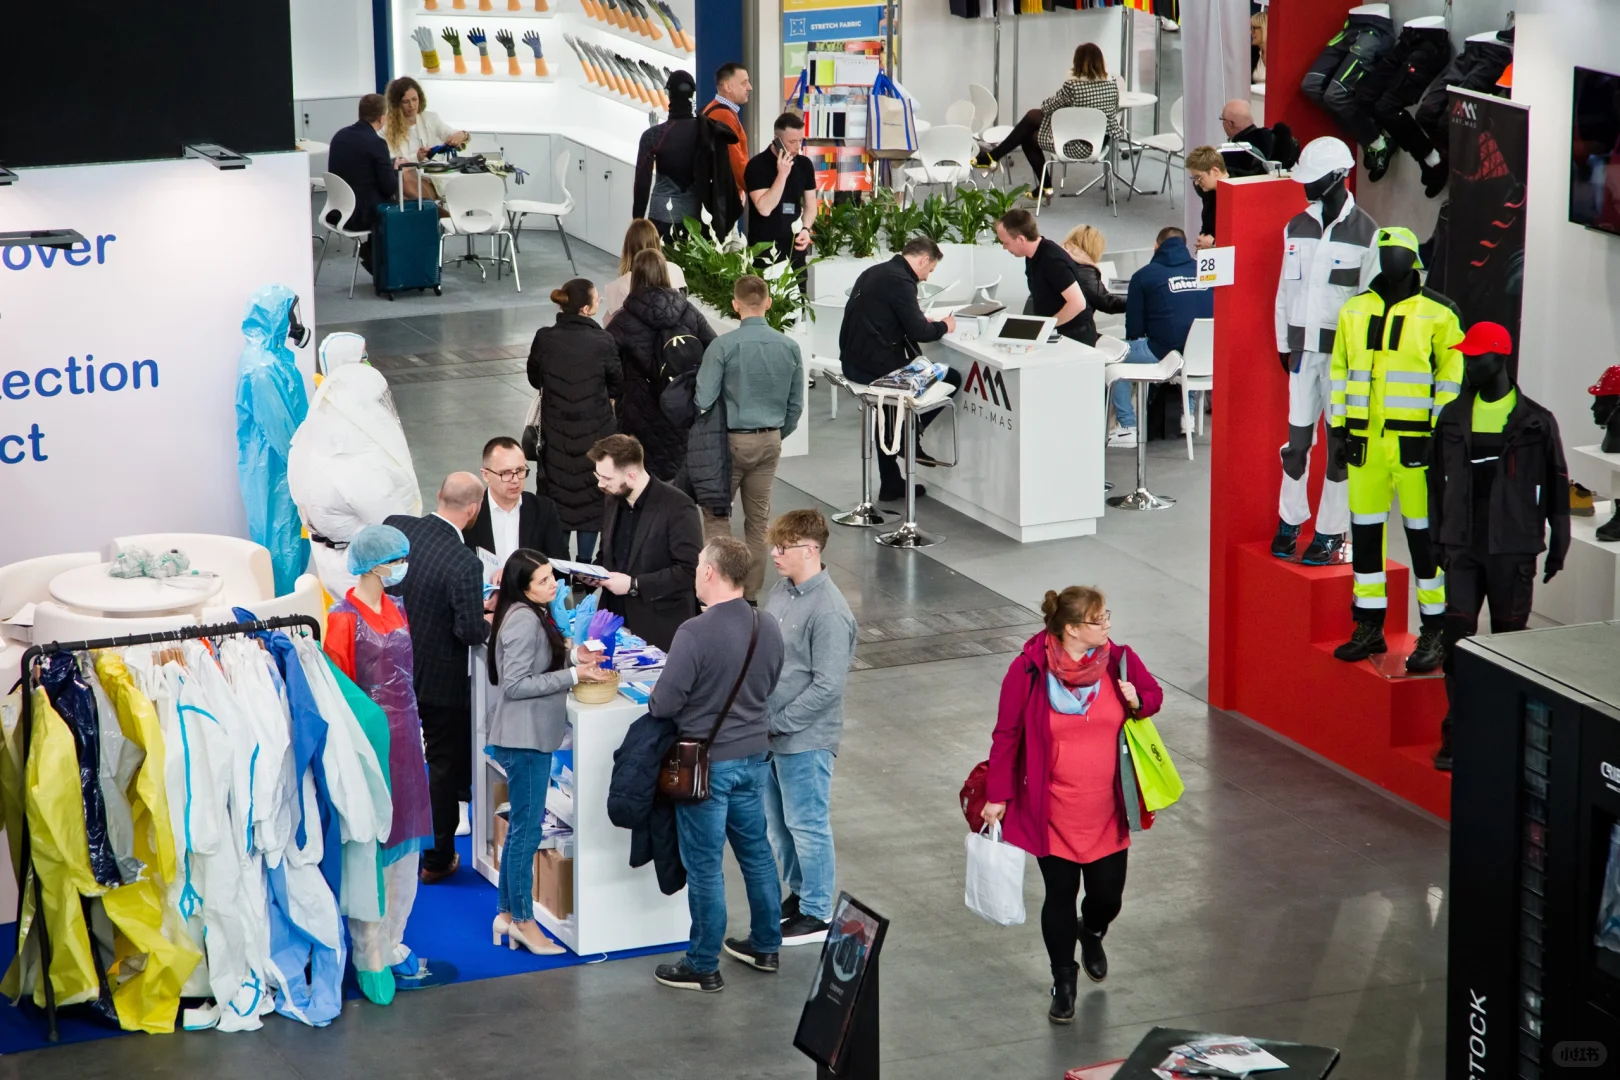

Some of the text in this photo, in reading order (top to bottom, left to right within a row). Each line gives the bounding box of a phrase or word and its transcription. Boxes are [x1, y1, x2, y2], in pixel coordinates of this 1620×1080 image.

[810, 20, 862, 31] STRETCH FABRIC
[1200, 258, 1216, 272] 28
[0, 354, 159, 400] ection
[963, 400, 1013, 431] ART.MAS
